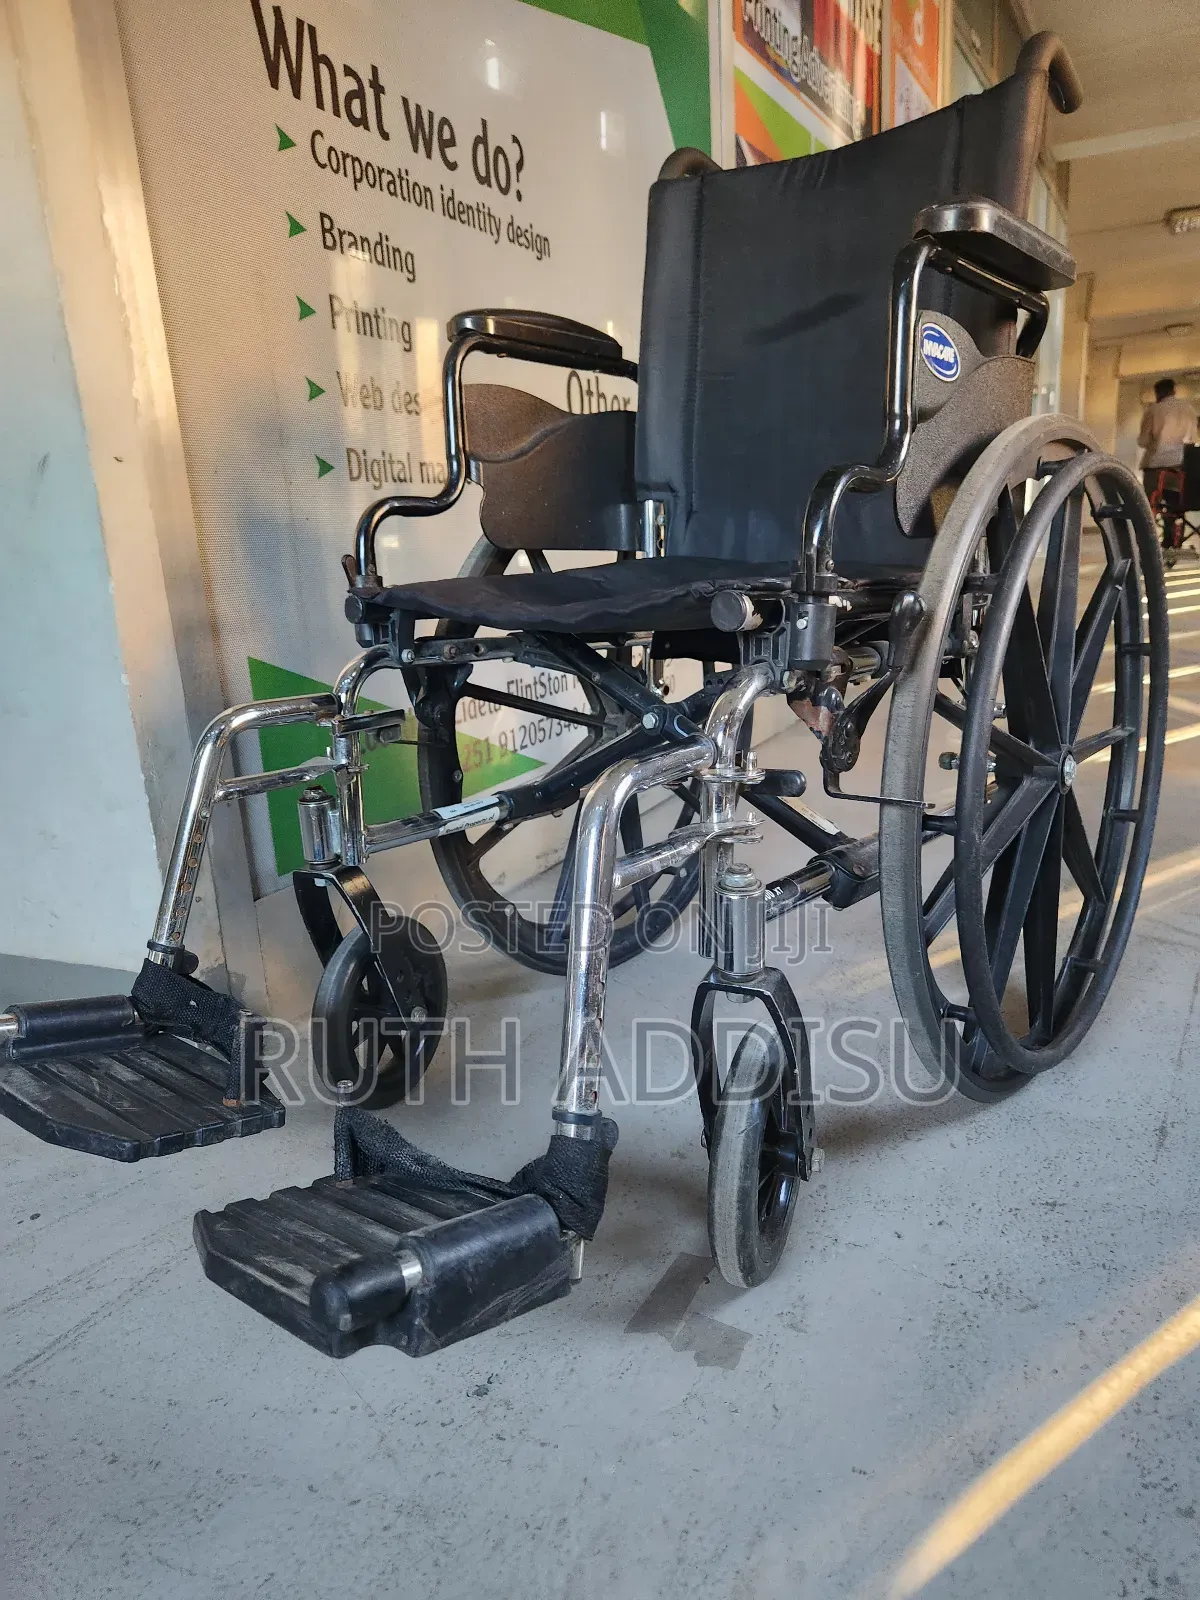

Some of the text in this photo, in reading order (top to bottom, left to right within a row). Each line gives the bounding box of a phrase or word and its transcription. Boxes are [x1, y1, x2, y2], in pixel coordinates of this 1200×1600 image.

[250, 0, 524, 202] What we do?
[310, 129, 551, 261] Corporation identity design
[319, 211, 417, 284] Branding
[328, 293, 412, 353] Printing
[336, 370, 383, 412] Web
[346, 447, 413, 491] Digital
